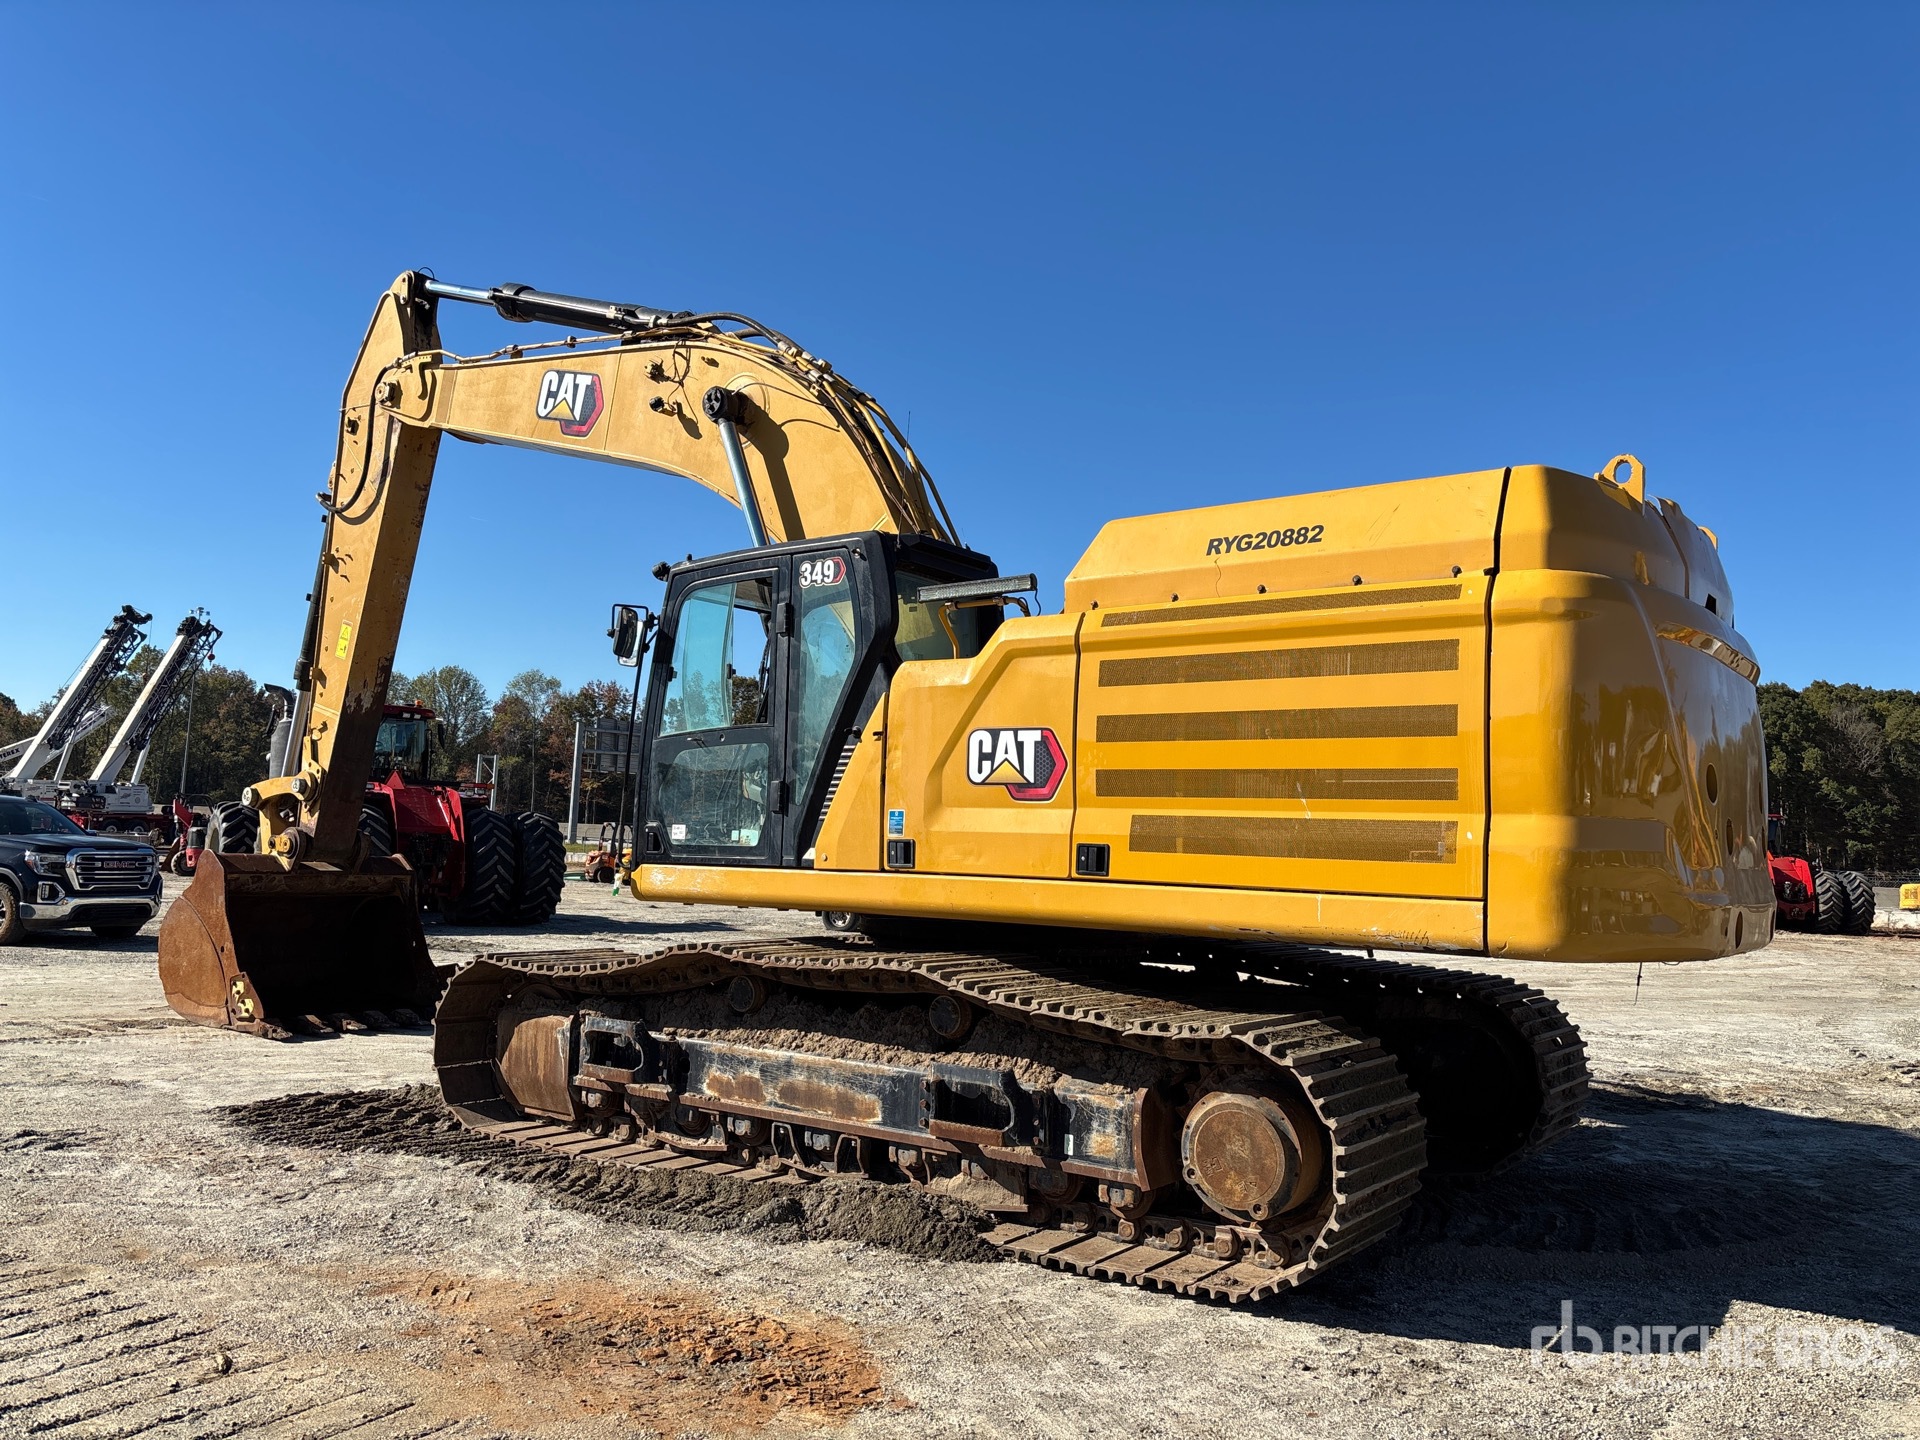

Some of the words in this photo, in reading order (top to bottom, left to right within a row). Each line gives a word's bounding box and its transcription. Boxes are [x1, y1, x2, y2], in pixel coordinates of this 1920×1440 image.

[537, 370, 593, 421] CAT
[1206, 524, 1325, 556] RYG20882
[801, 559, 835, 586] 349
[968, 730, 1042, 784] CAT
